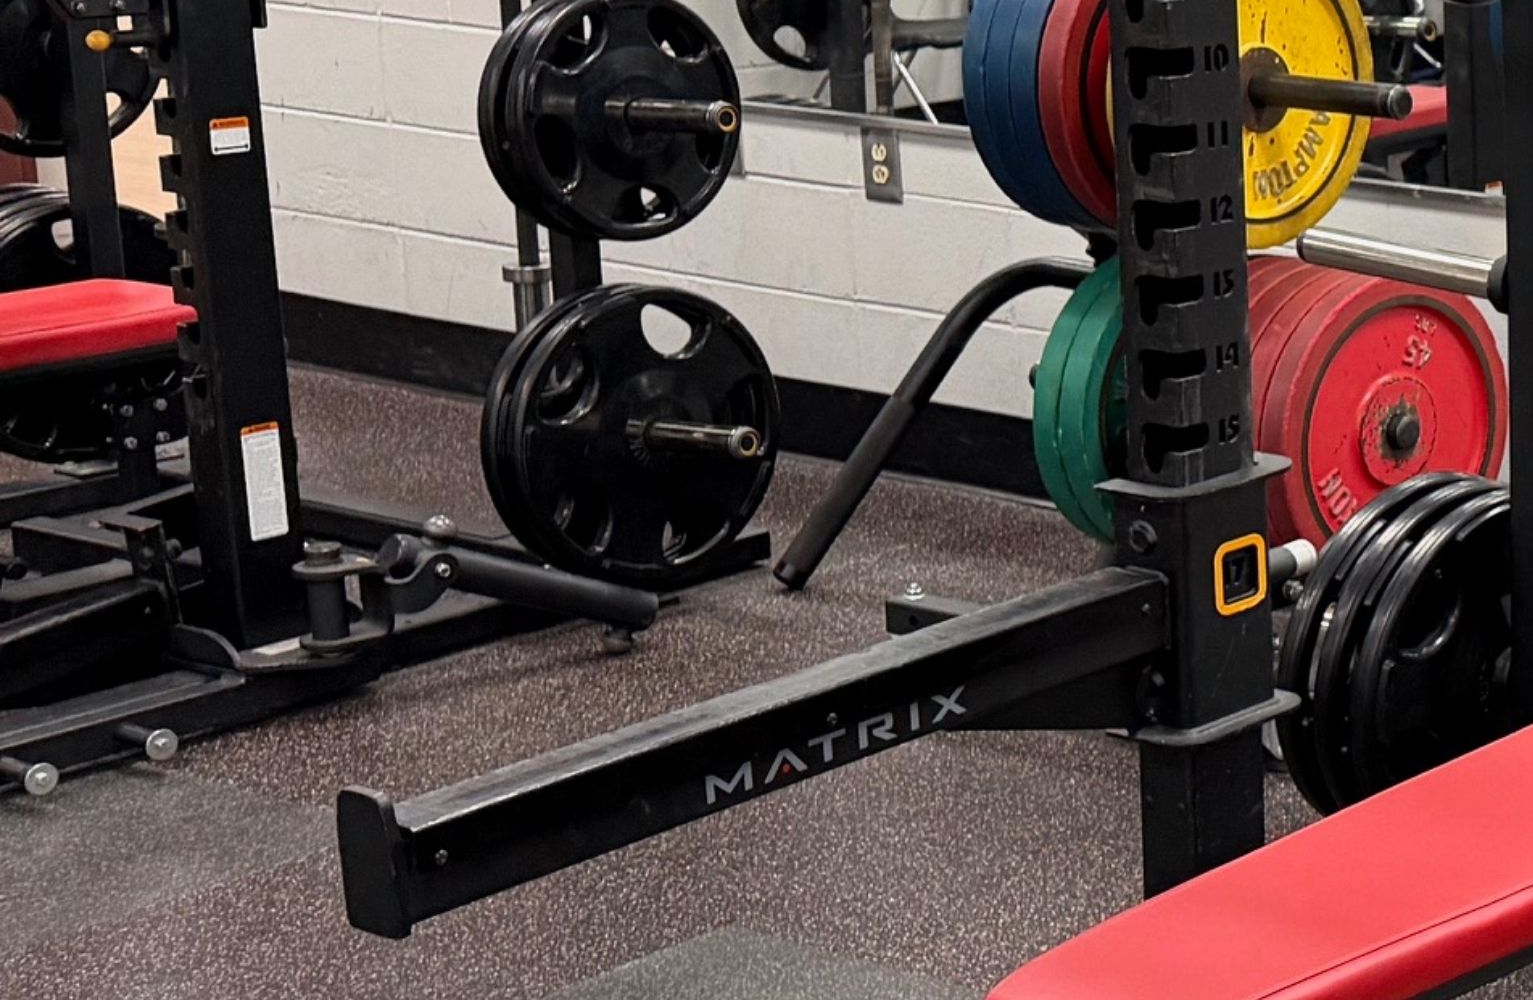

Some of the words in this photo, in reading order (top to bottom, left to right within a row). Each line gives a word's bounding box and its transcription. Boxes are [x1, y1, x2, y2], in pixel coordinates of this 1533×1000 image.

[1204, 44, 1230, 72] 10
[1207, 121, 1229, 148] 11
[1210, 195, 1234, 224] 12
[1216, 342, 1240, 371] 14
[1219, 414, 1241, 445] 15
[704, 684, 968, 806] MATRIX
